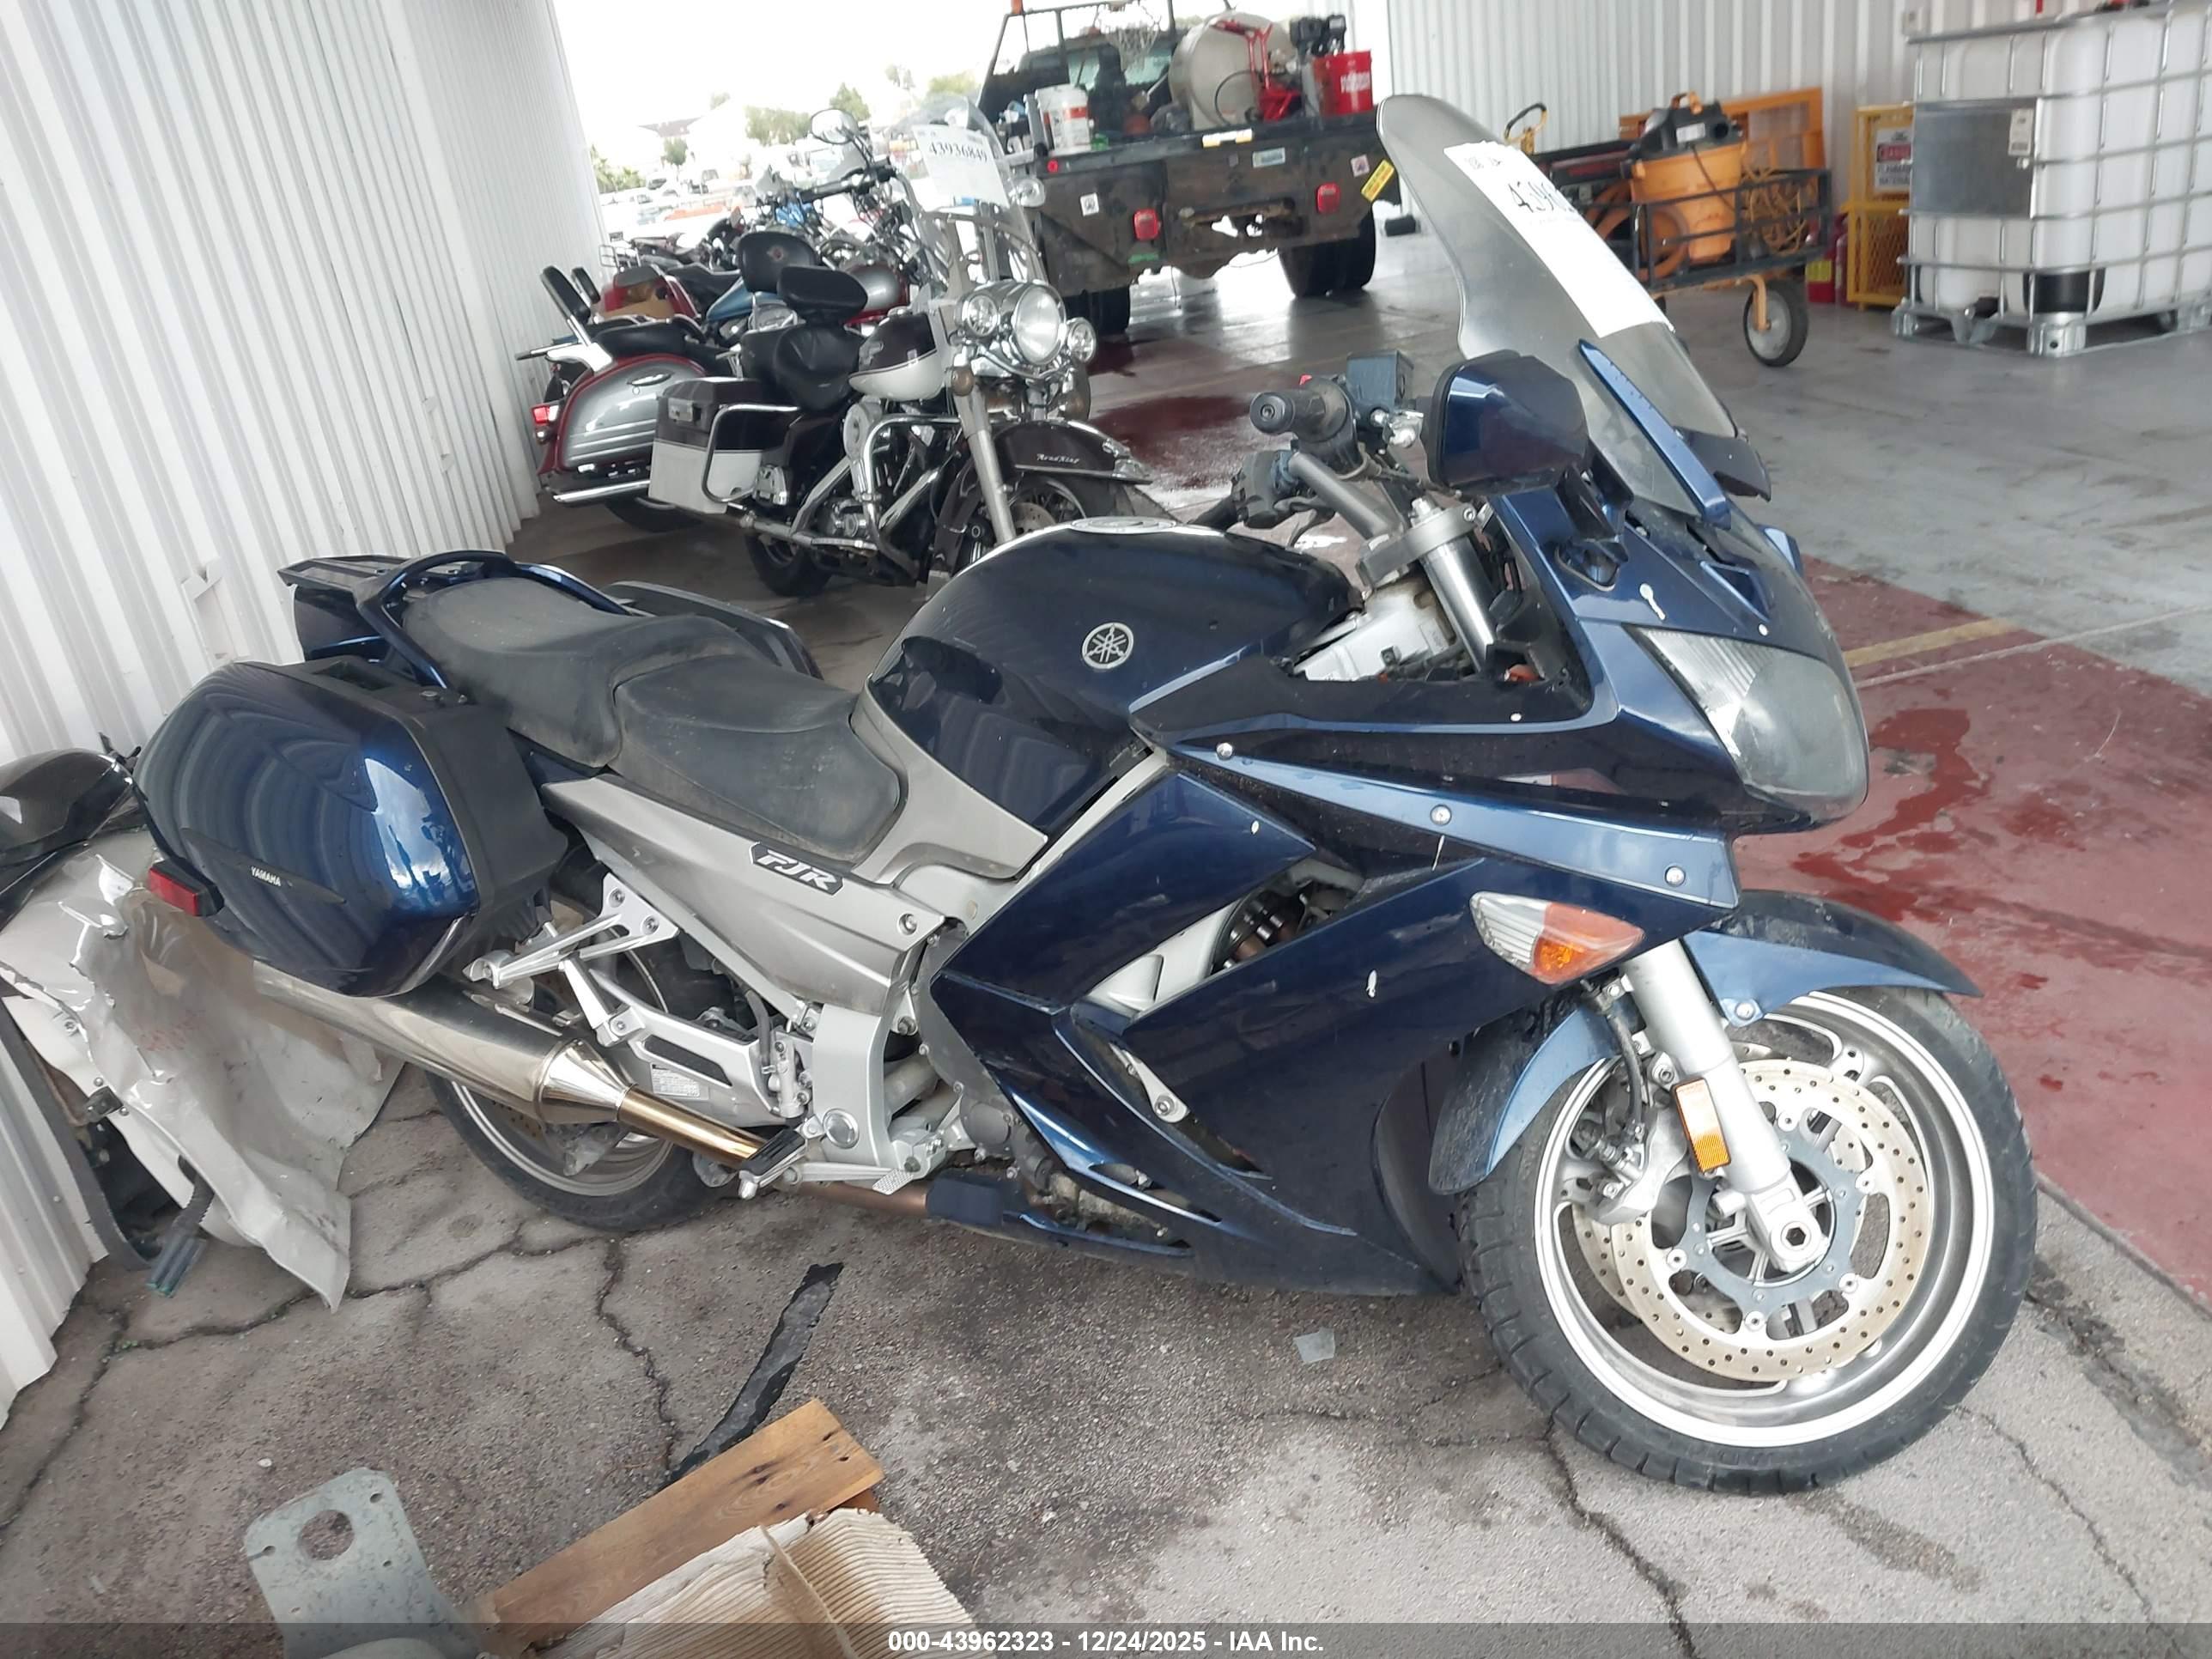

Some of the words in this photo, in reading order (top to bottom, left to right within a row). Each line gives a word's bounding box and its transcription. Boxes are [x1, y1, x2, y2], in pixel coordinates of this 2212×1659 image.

[929, 142, 988, 162] 43936849
[251, 866, 282, 887] YAMAHA
[757, 848, 837, 890] FJR
